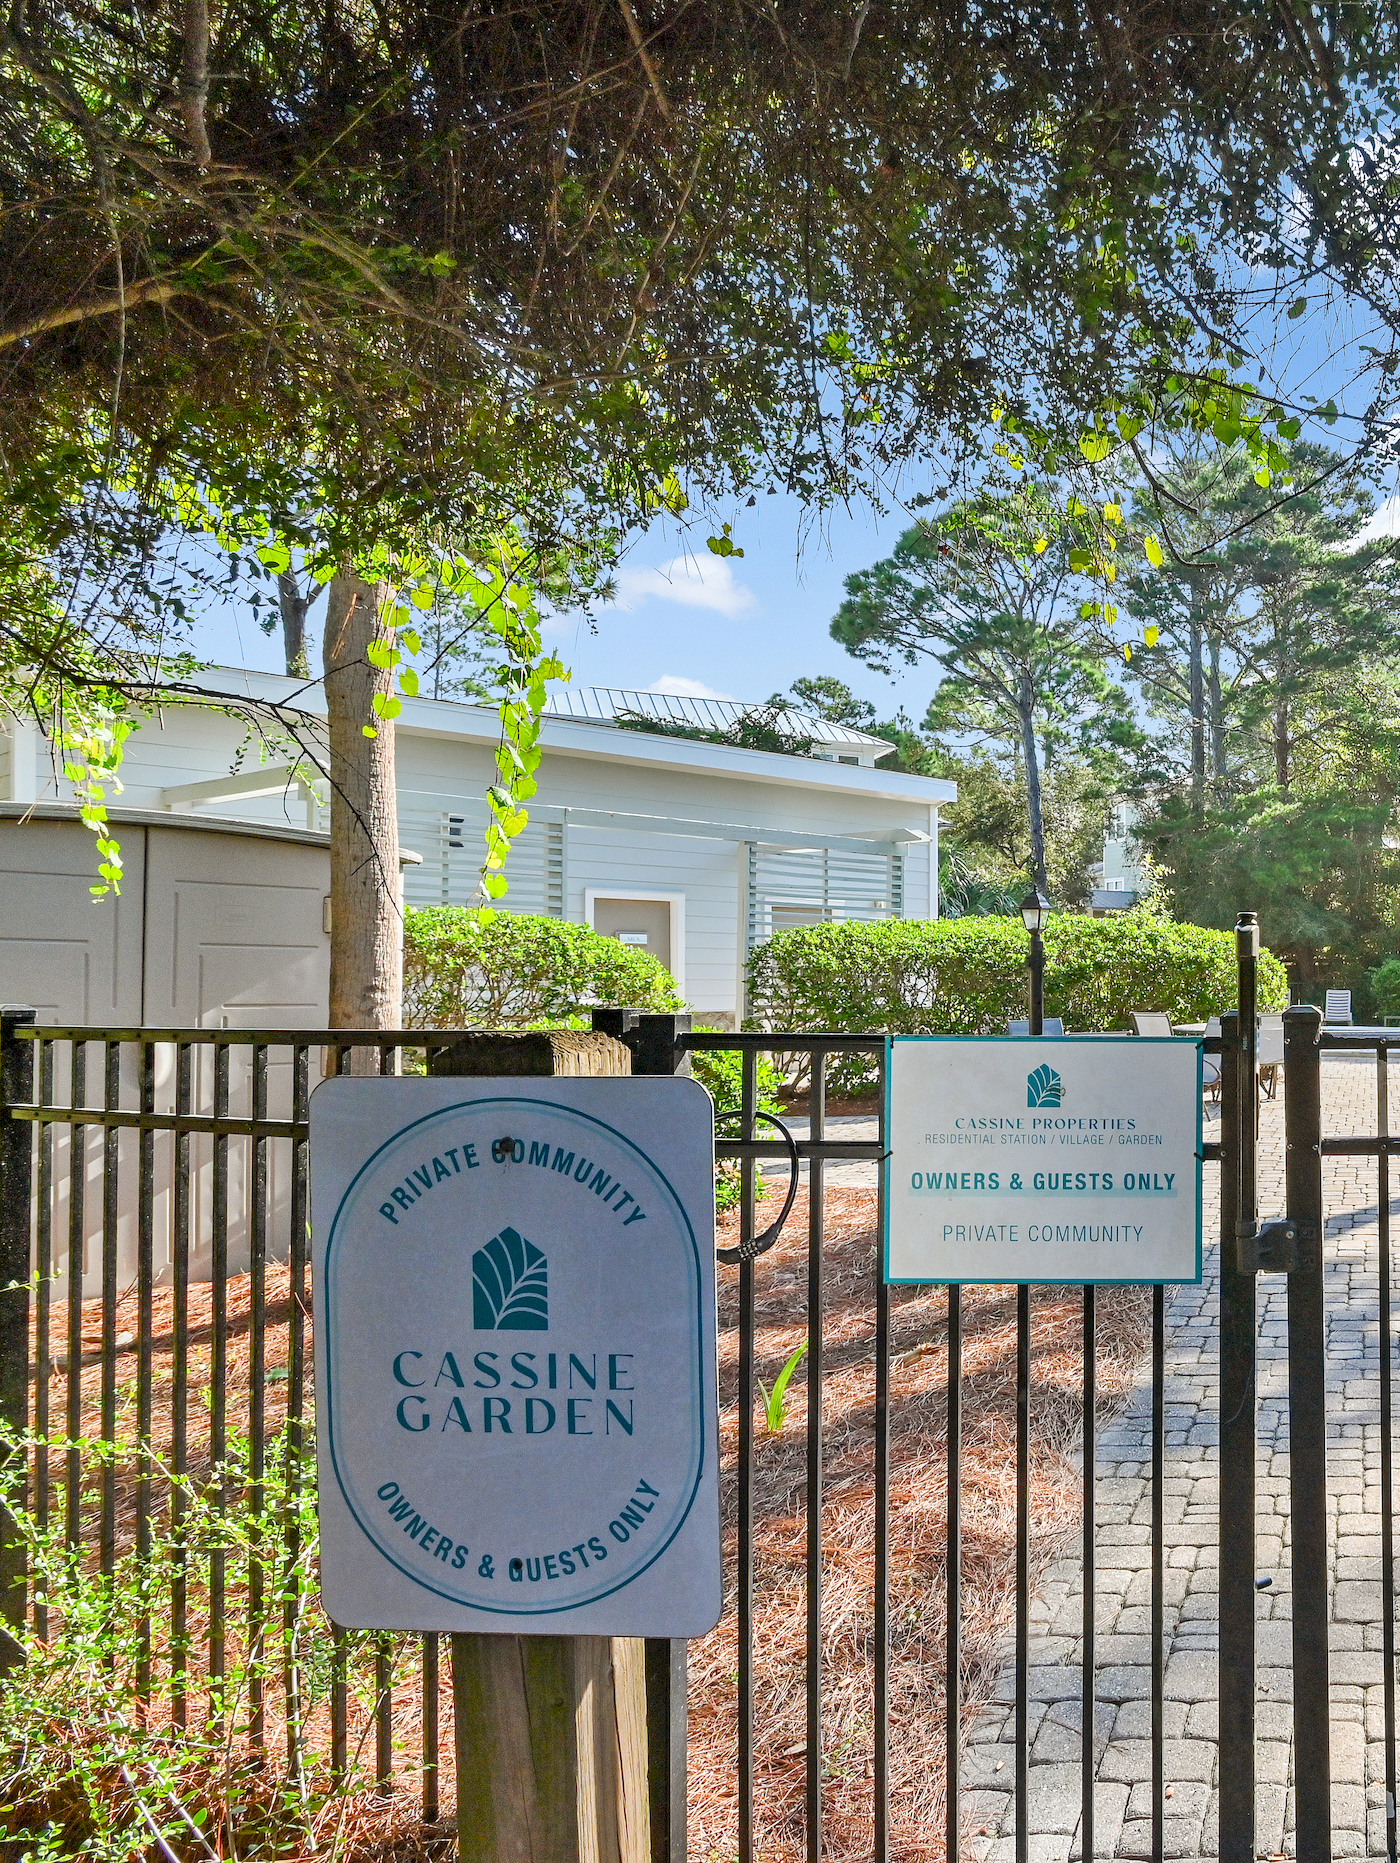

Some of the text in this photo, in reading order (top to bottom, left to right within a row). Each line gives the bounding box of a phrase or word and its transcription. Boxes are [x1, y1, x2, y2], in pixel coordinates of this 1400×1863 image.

[955, 1117, 1137, 1130] CASSINE PROPERTIES
[925, 1133, 996, 1145] RESIDENTIAL
[1000, 1133, 1046, 1145] STATION
[1059, 1134, 1105, 1145] VILLAGE
[1118, 1134, 1163, 1146] GARDEN
[378, 1138, 647, 1226] PRIVATE COMMUNITY
[911, 1172, 1176, 1191] OWNERS & GUESTS ONLY
[943, 1225, 1144, 1242] PRIVATE COMMUNITY
[392, 1350, 636, 1392] CASSINE
[396, 1395, 635, 1437] GARDEN
[377, 1478, 661, 1582] OWNERS & GUESTS ONLY
